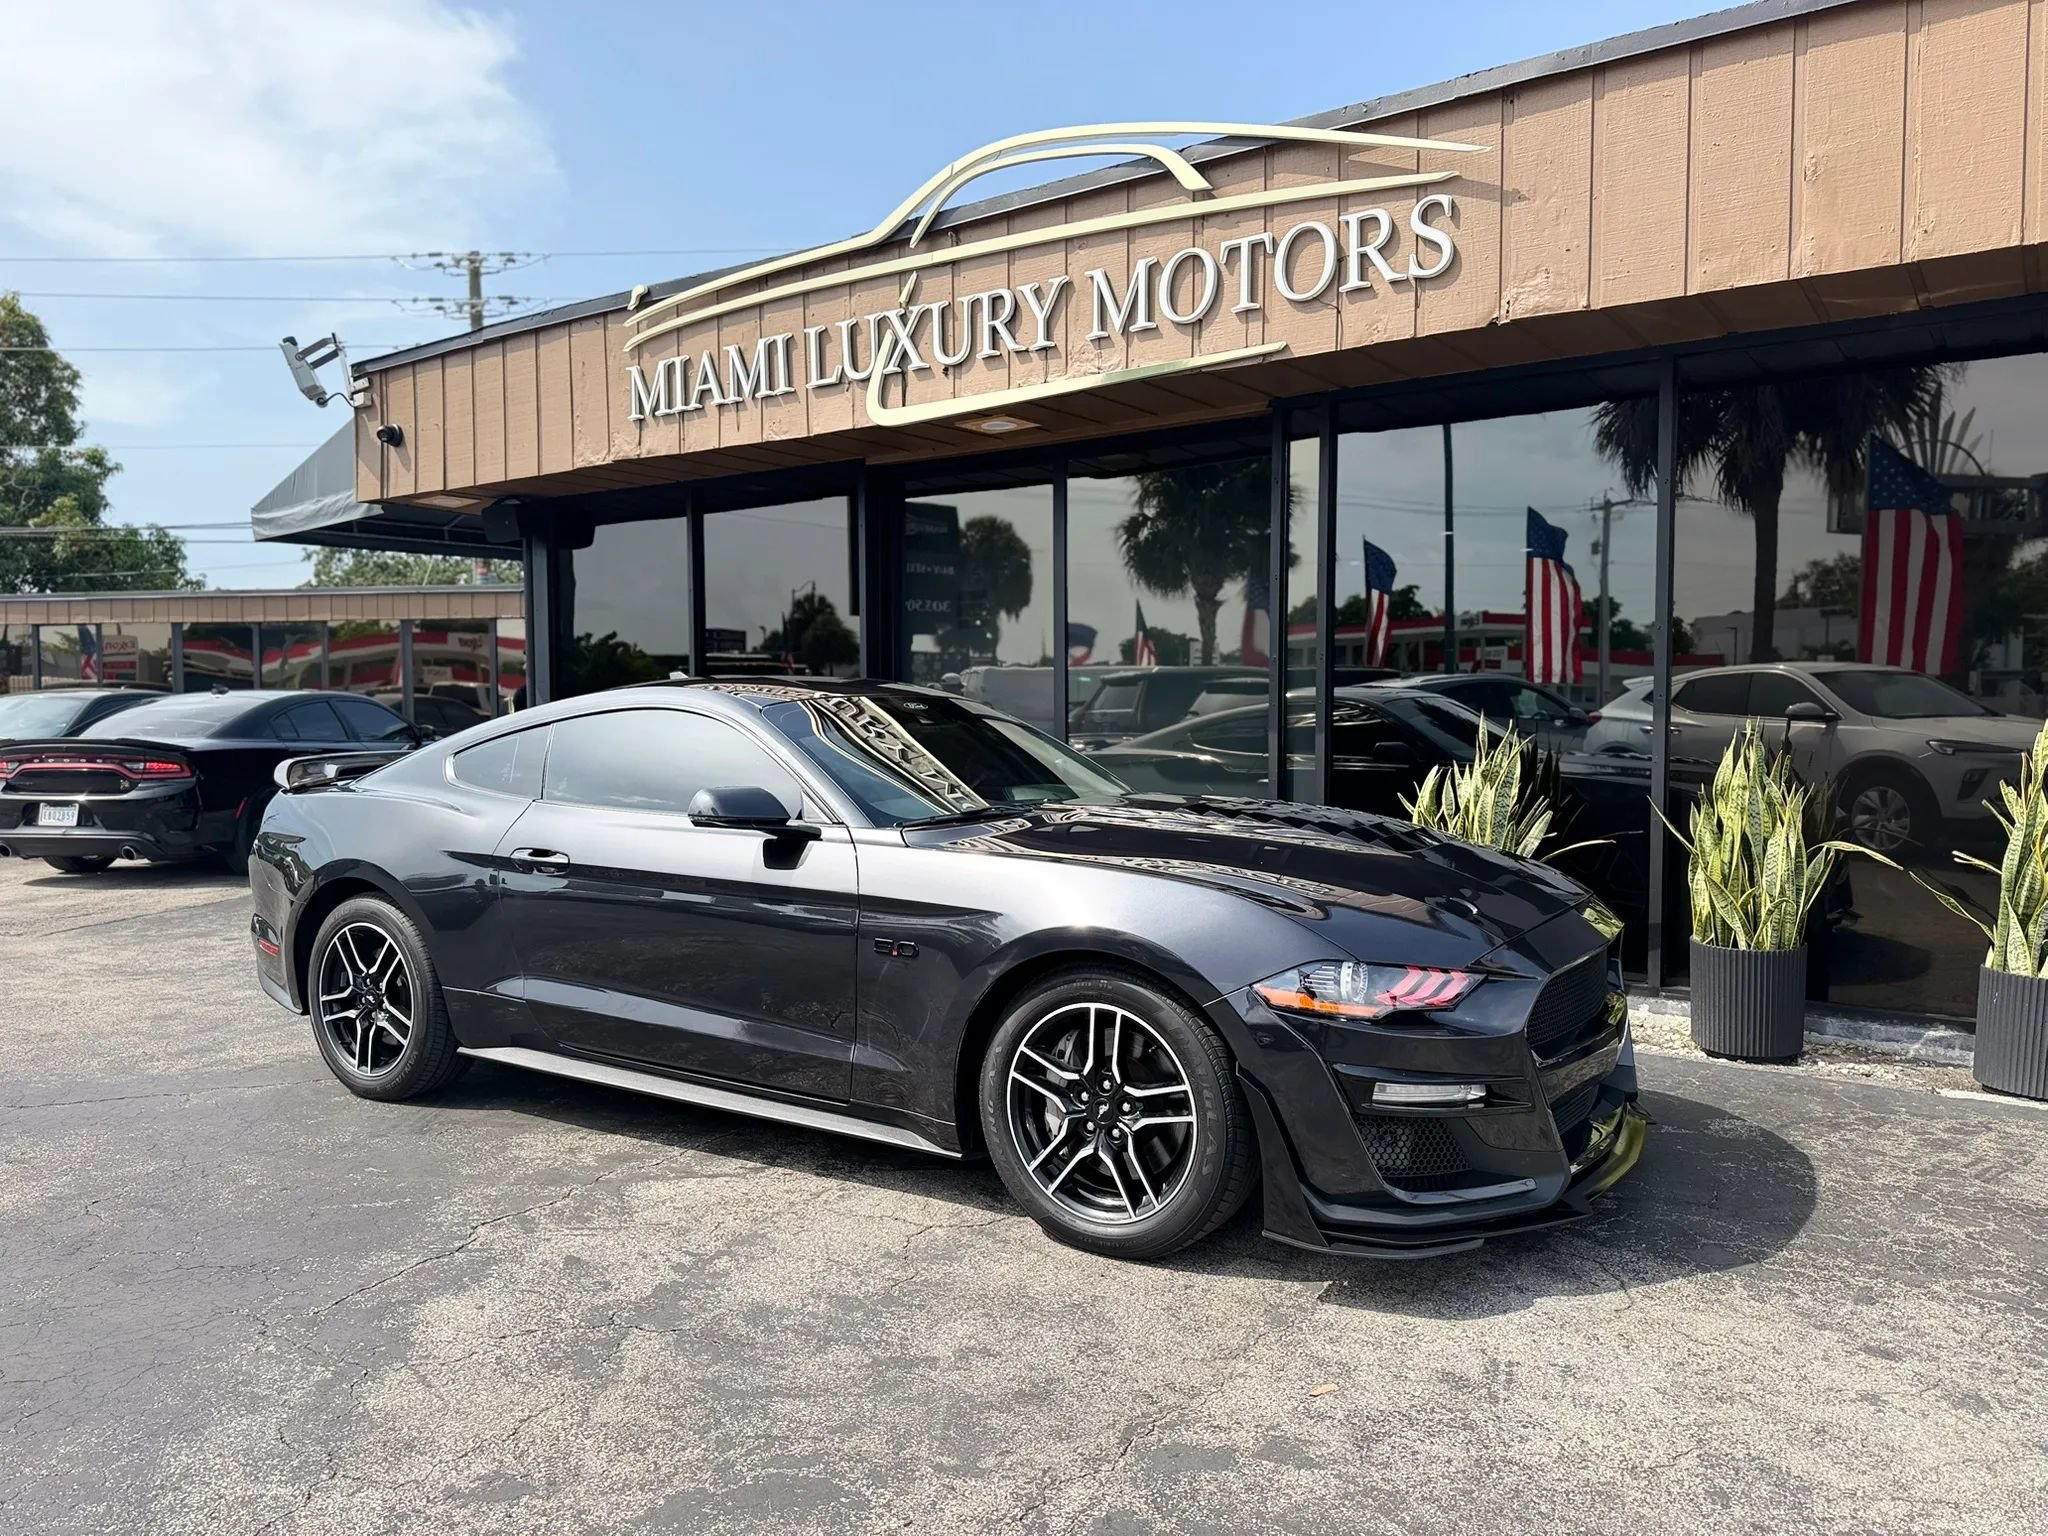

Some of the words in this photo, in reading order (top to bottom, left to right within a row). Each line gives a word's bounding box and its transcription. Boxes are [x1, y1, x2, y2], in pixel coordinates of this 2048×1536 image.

[626, 332, 795, 421] MIAMI
[804, 275, 1069, 389] LUXURY
[1085, 194, 1455, 341] MOTORS
[873, 937, 919, 959] 5.0
